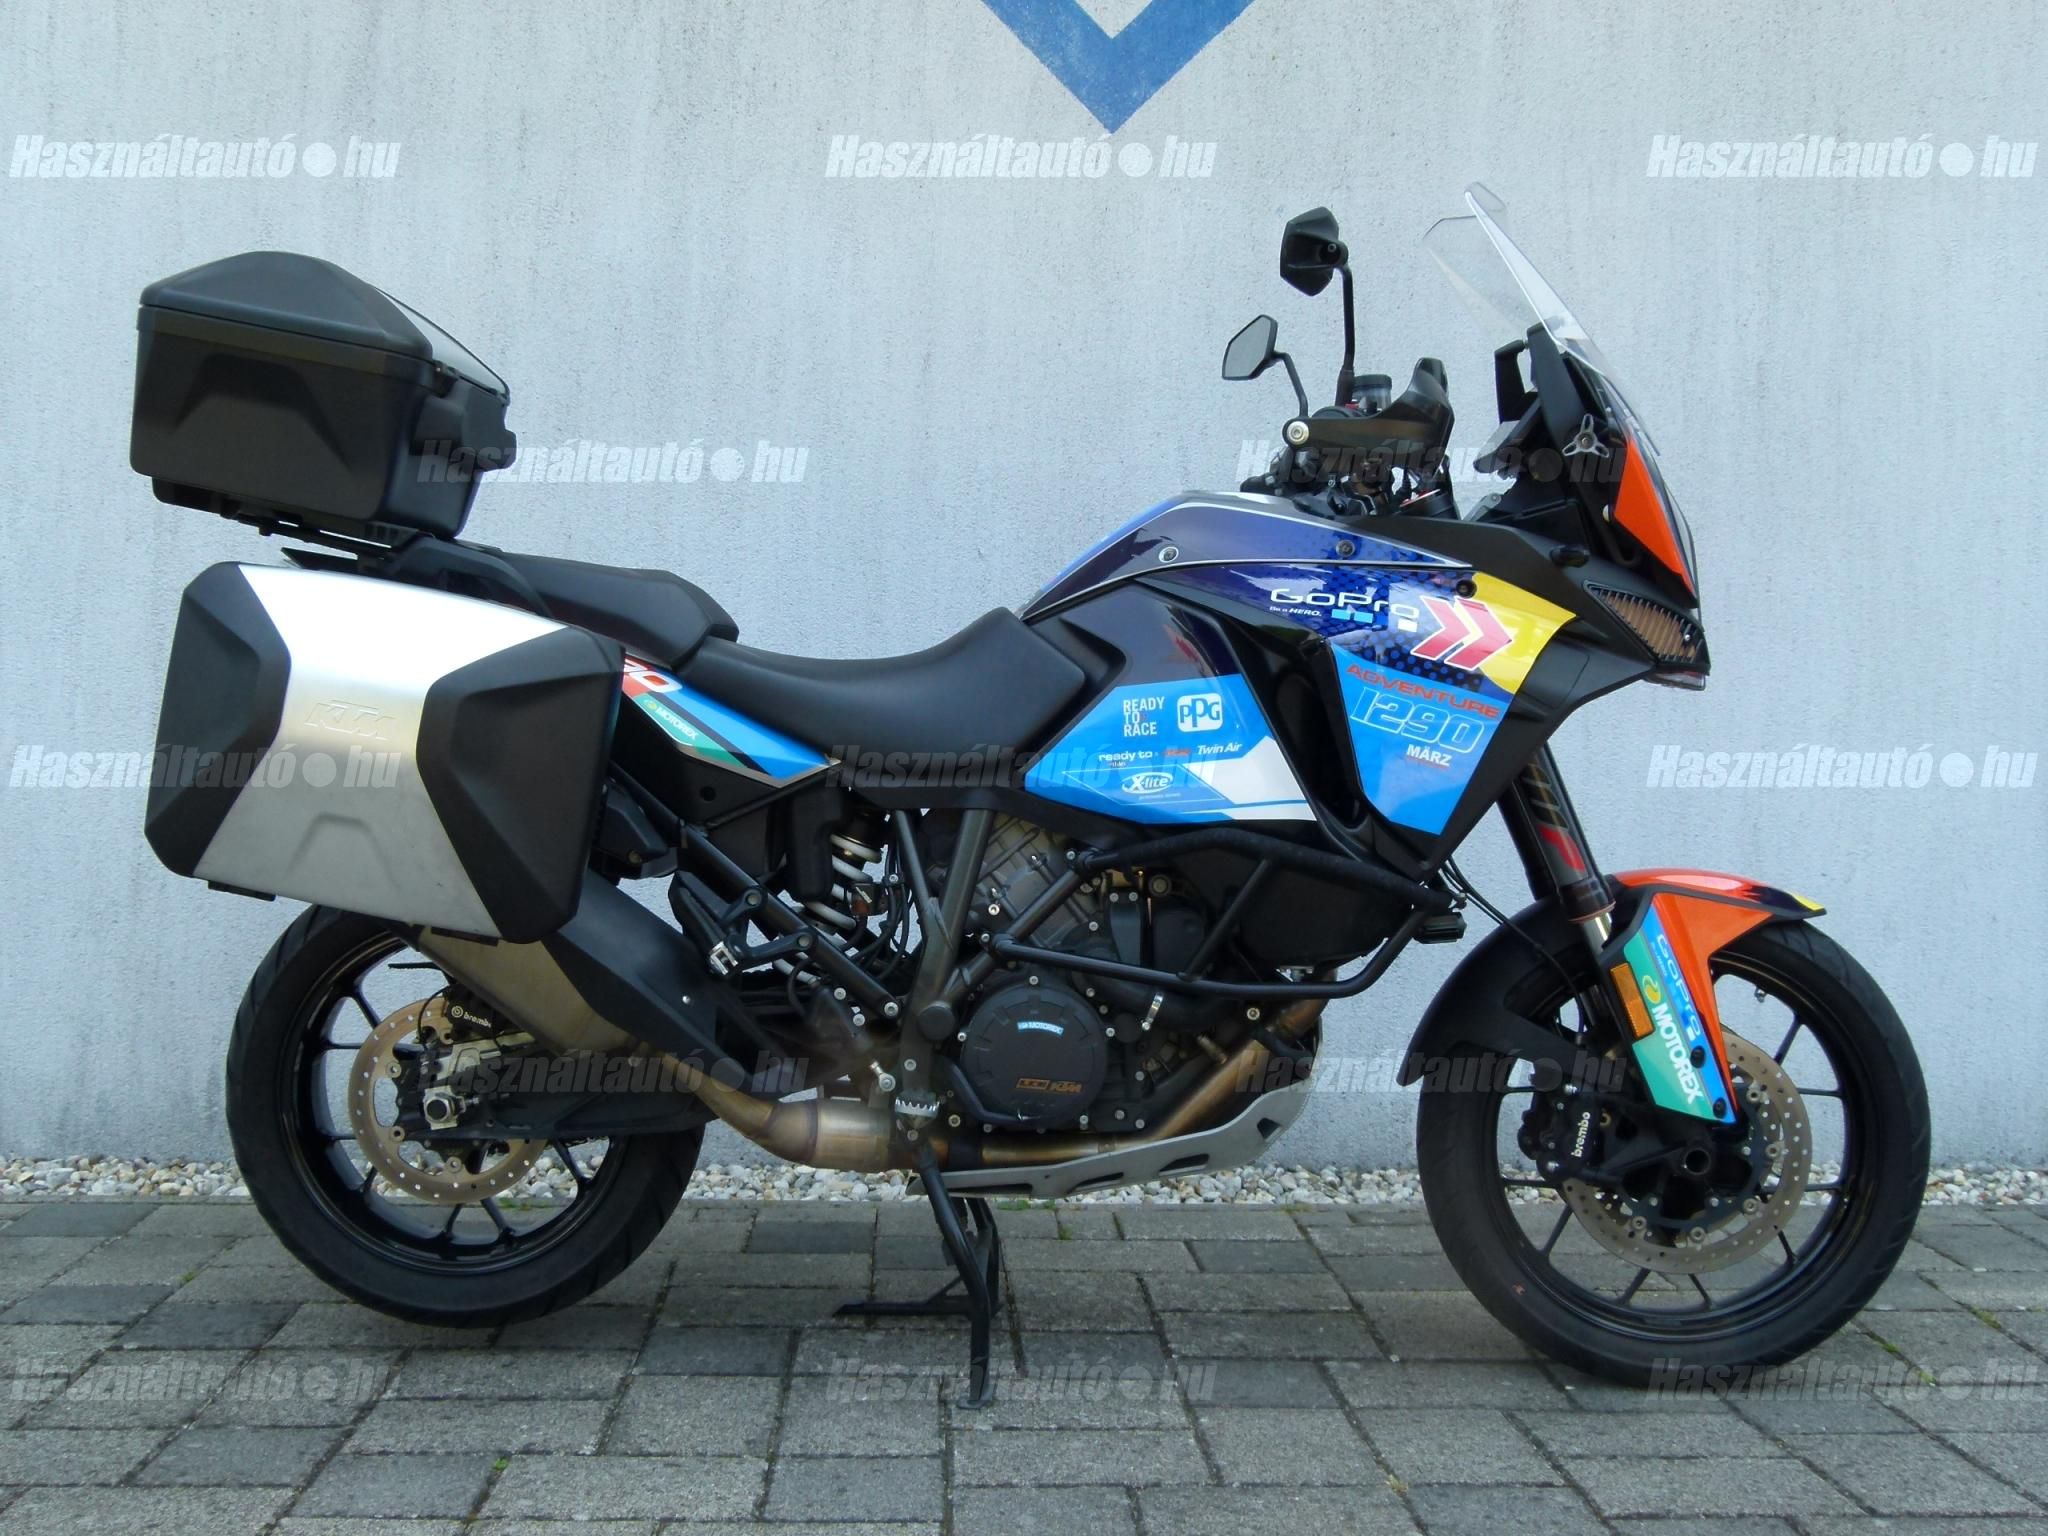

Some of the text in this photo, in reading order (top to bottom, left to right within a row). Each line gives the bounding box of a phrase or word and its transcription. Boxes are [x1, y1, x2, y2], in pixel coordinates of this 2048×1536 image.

[1271, 588, 1420, 618] GoPro
[1123, 697, 1165, 713] READY
[1346, 664, 1499, 718] ADVENTURE
[656, 706, 699, 740] MOTOREX
[1124, 711, 1141, 725] TO
[1179, 697, 1221, 729] PPG
[1350, 686, 1485, 754] 1290
[1124, 722, 1157, 737] RACE
[1098, 750, 1137, 761] ready
[1138, 749, 1153, 759] to
[1197, 744, 1223, 755] Twin
[1224, 742, 1243, 752] Air
[1406, 743, 1452, 767] MÄRZ
[1652, 1003, 1704, 1104] MOTOREX
[1571, 1111, 1591, 1158] brembo
